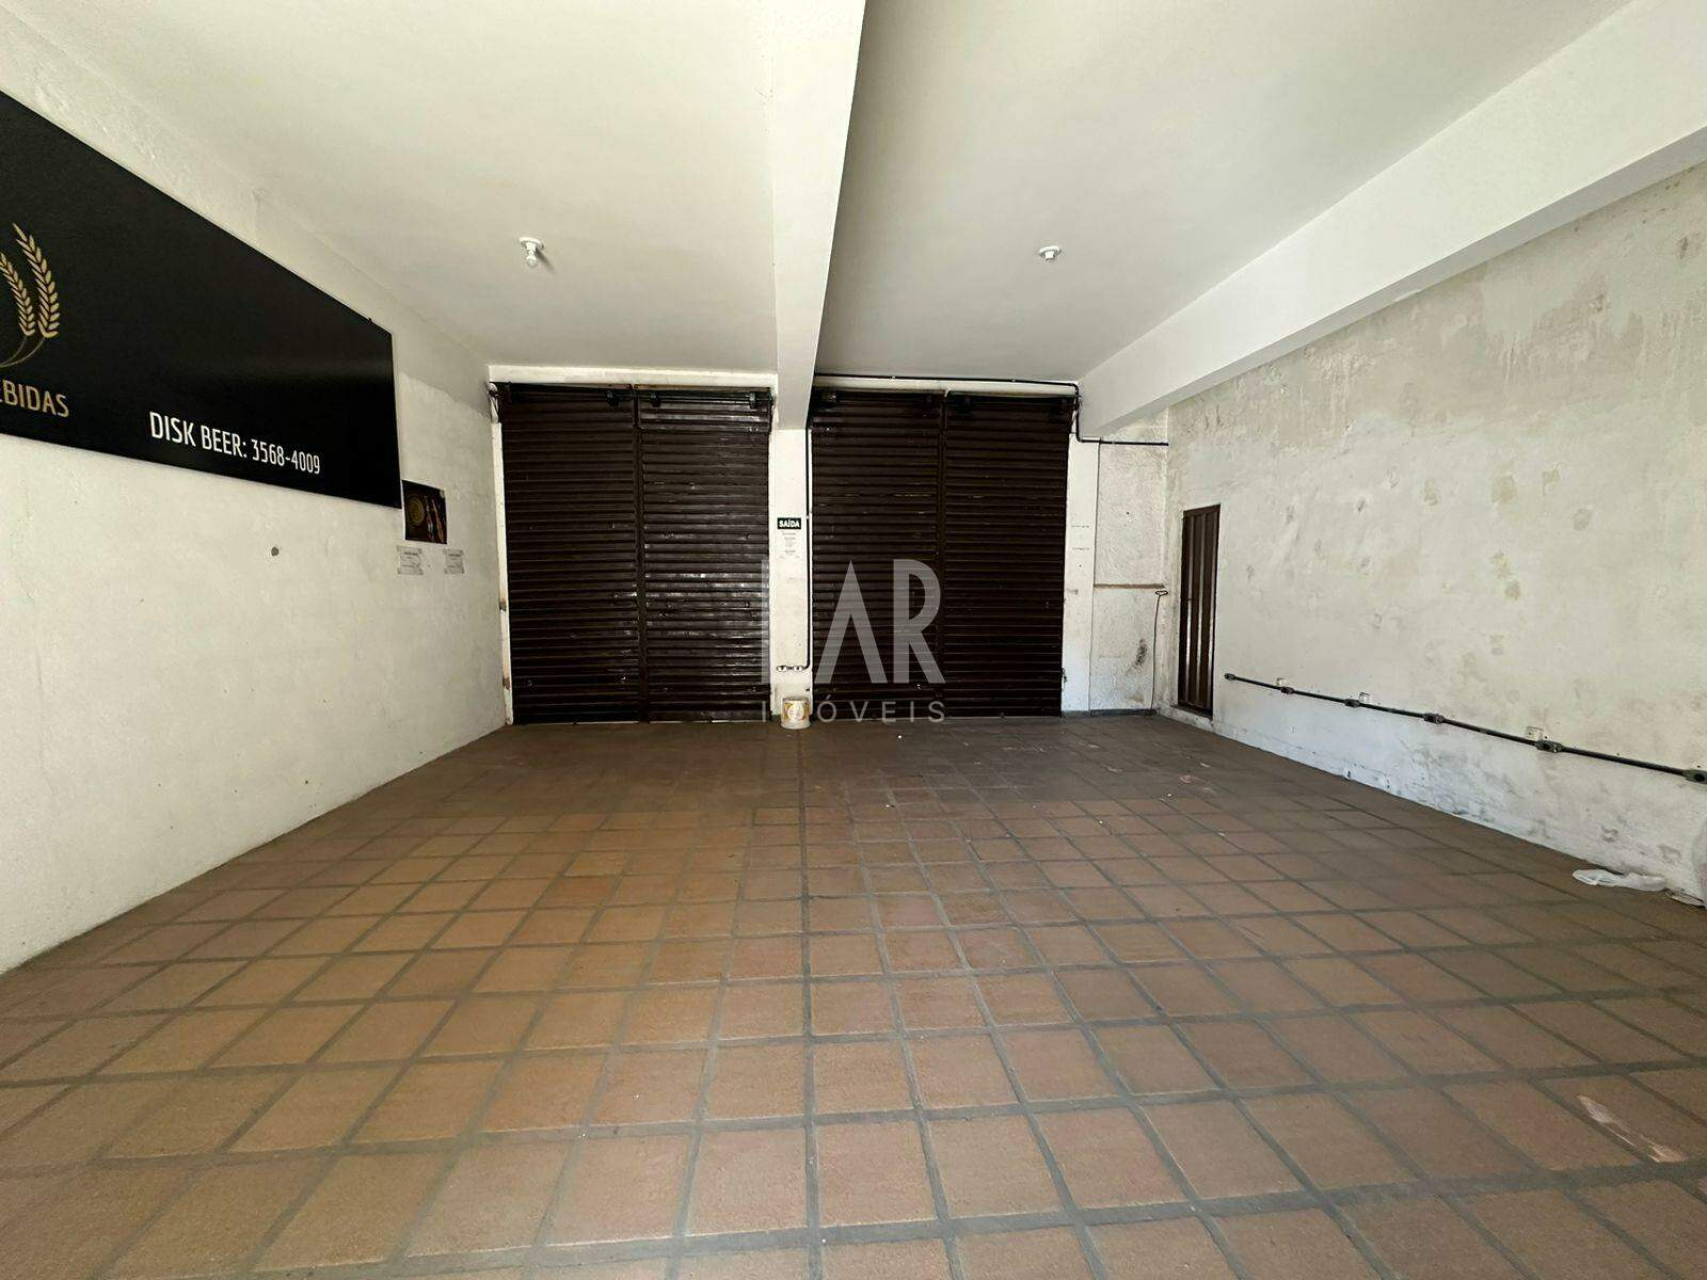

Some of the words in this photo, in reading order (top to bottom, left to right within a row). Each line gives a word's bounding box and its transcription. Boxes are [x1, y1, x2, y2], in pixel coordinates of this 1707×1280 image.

[0, 379, 69, 417] BIDAS
[149, 411, 196, 447] DISK
[200, 425, 247, 458] BEER:
[251, 438, 320, 475] 3568-4009
[778, 518, 800, 528] SAÍDA
